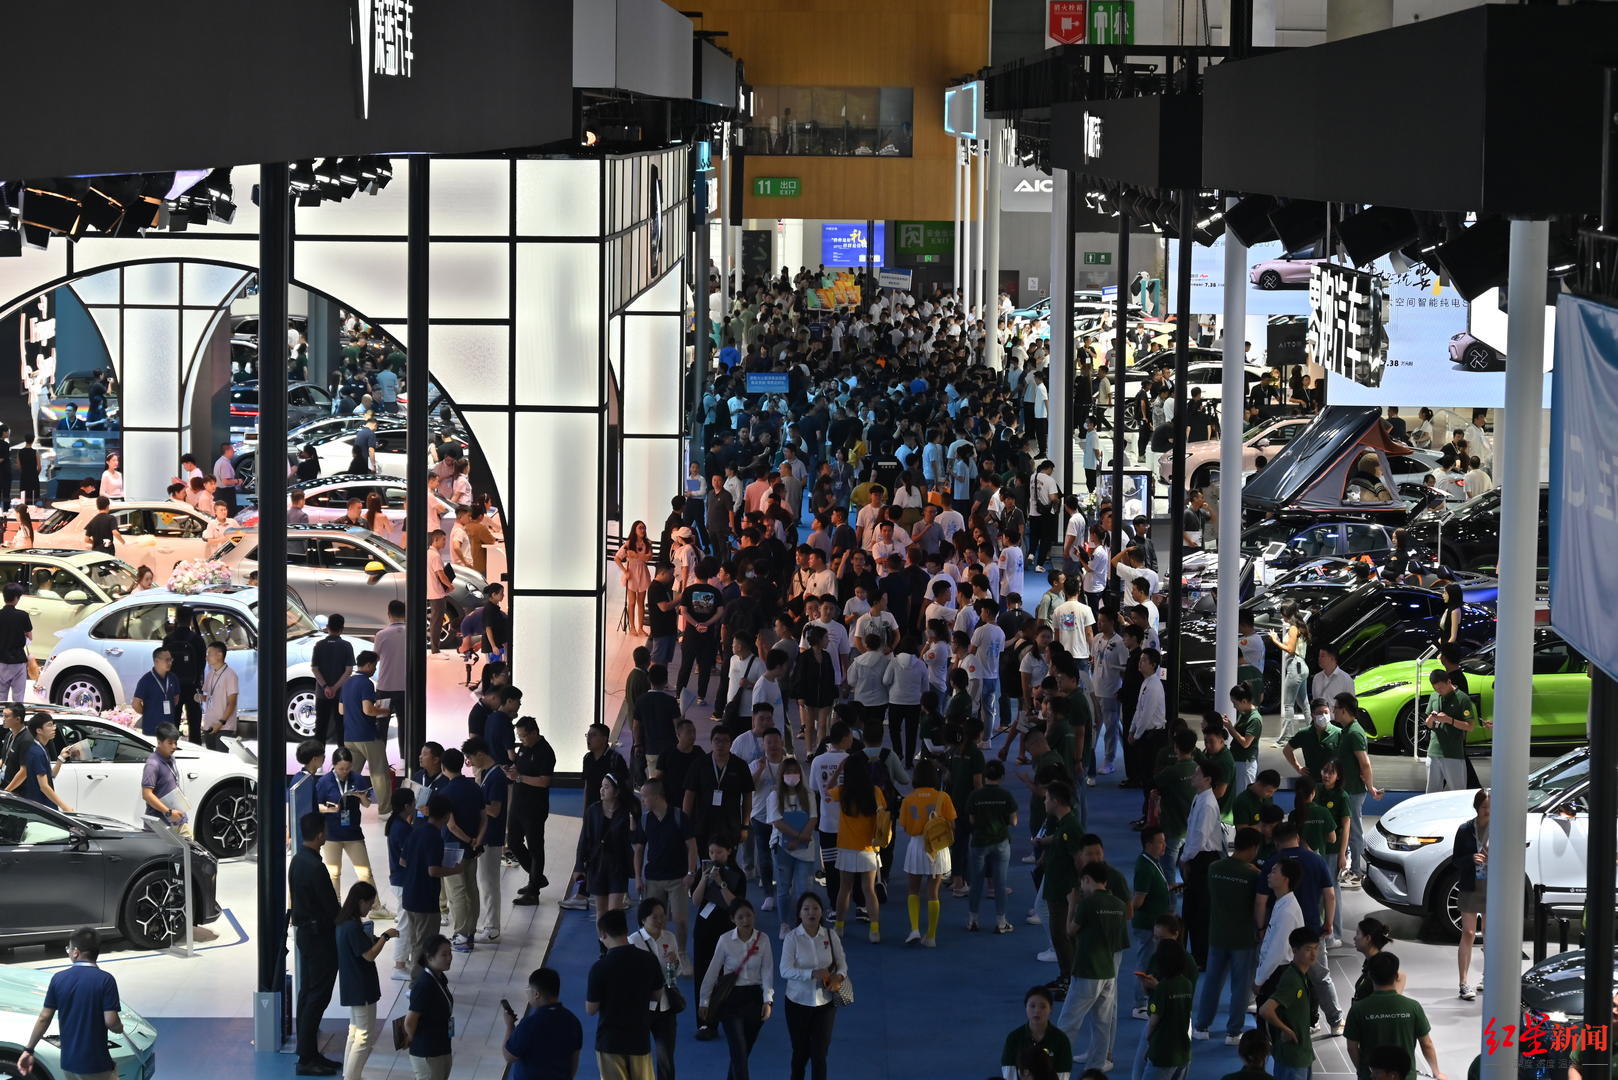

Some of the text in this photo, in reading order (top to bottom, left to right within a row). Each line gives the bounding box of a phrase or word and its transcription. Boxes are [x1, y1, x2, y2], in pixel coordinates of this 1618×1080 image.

[757, 180, 771, 195] 11
[780, 179, 797, 189] 出口
[1389, 297, 1469, 309] 空间智能纯电S
[1306, 263, 1364, 383] 零跑汽车
[1365, 1012, 1411, 1020] LEAPMOTOR
